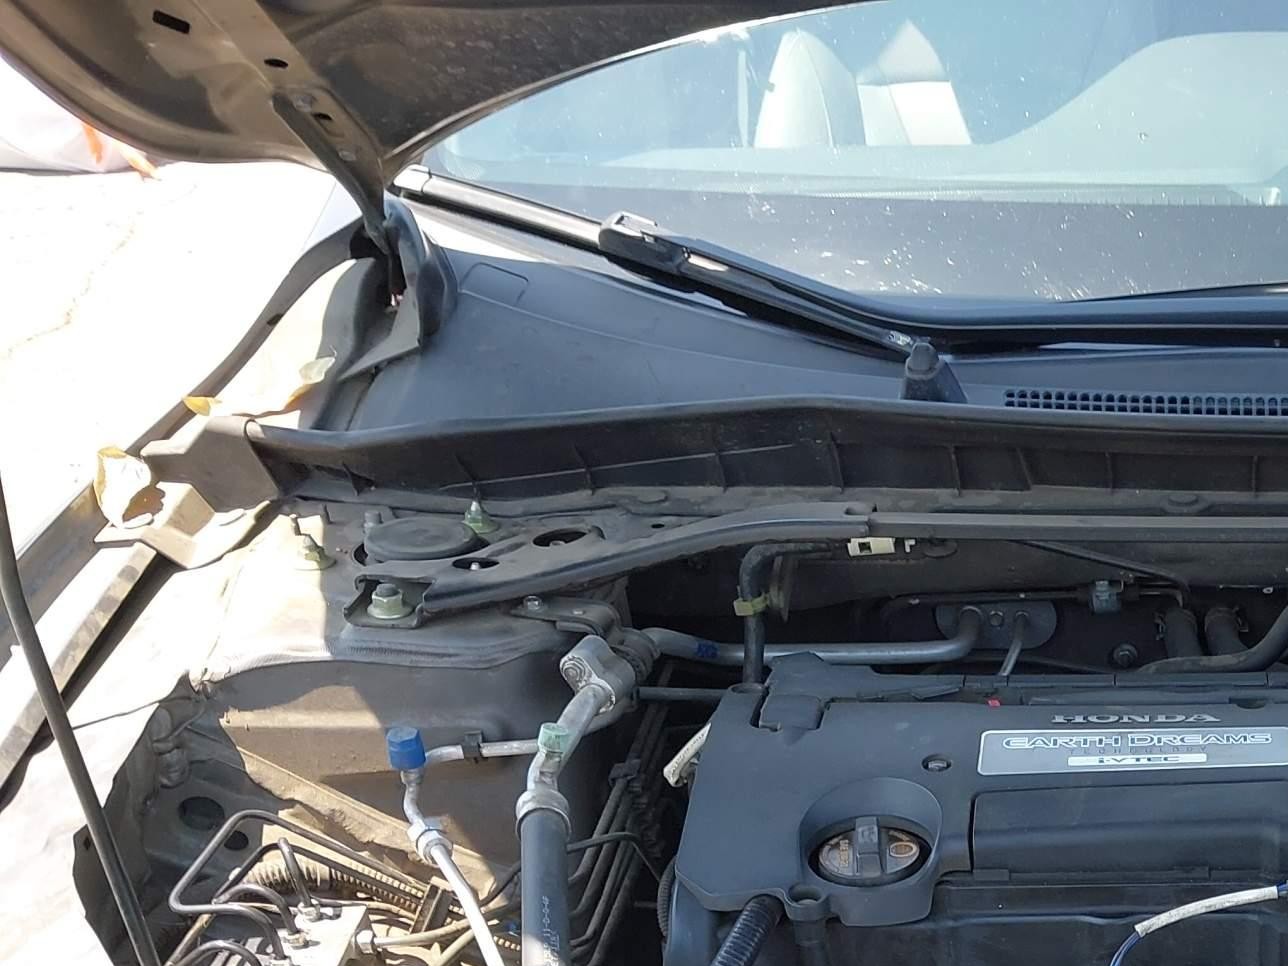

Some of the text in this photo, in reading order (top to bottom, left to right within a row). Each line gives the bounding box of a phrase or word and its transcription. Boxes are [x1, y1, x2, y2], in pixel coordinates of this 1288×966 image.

[1051, 712, 1221, 725] HONDA
[1003, 732, 1273, 750] EARTH DREAMS
[1068, 745, 1208, 755] TECHNOLOGY
[1097, 755, 1180, 764] i-VTEC
